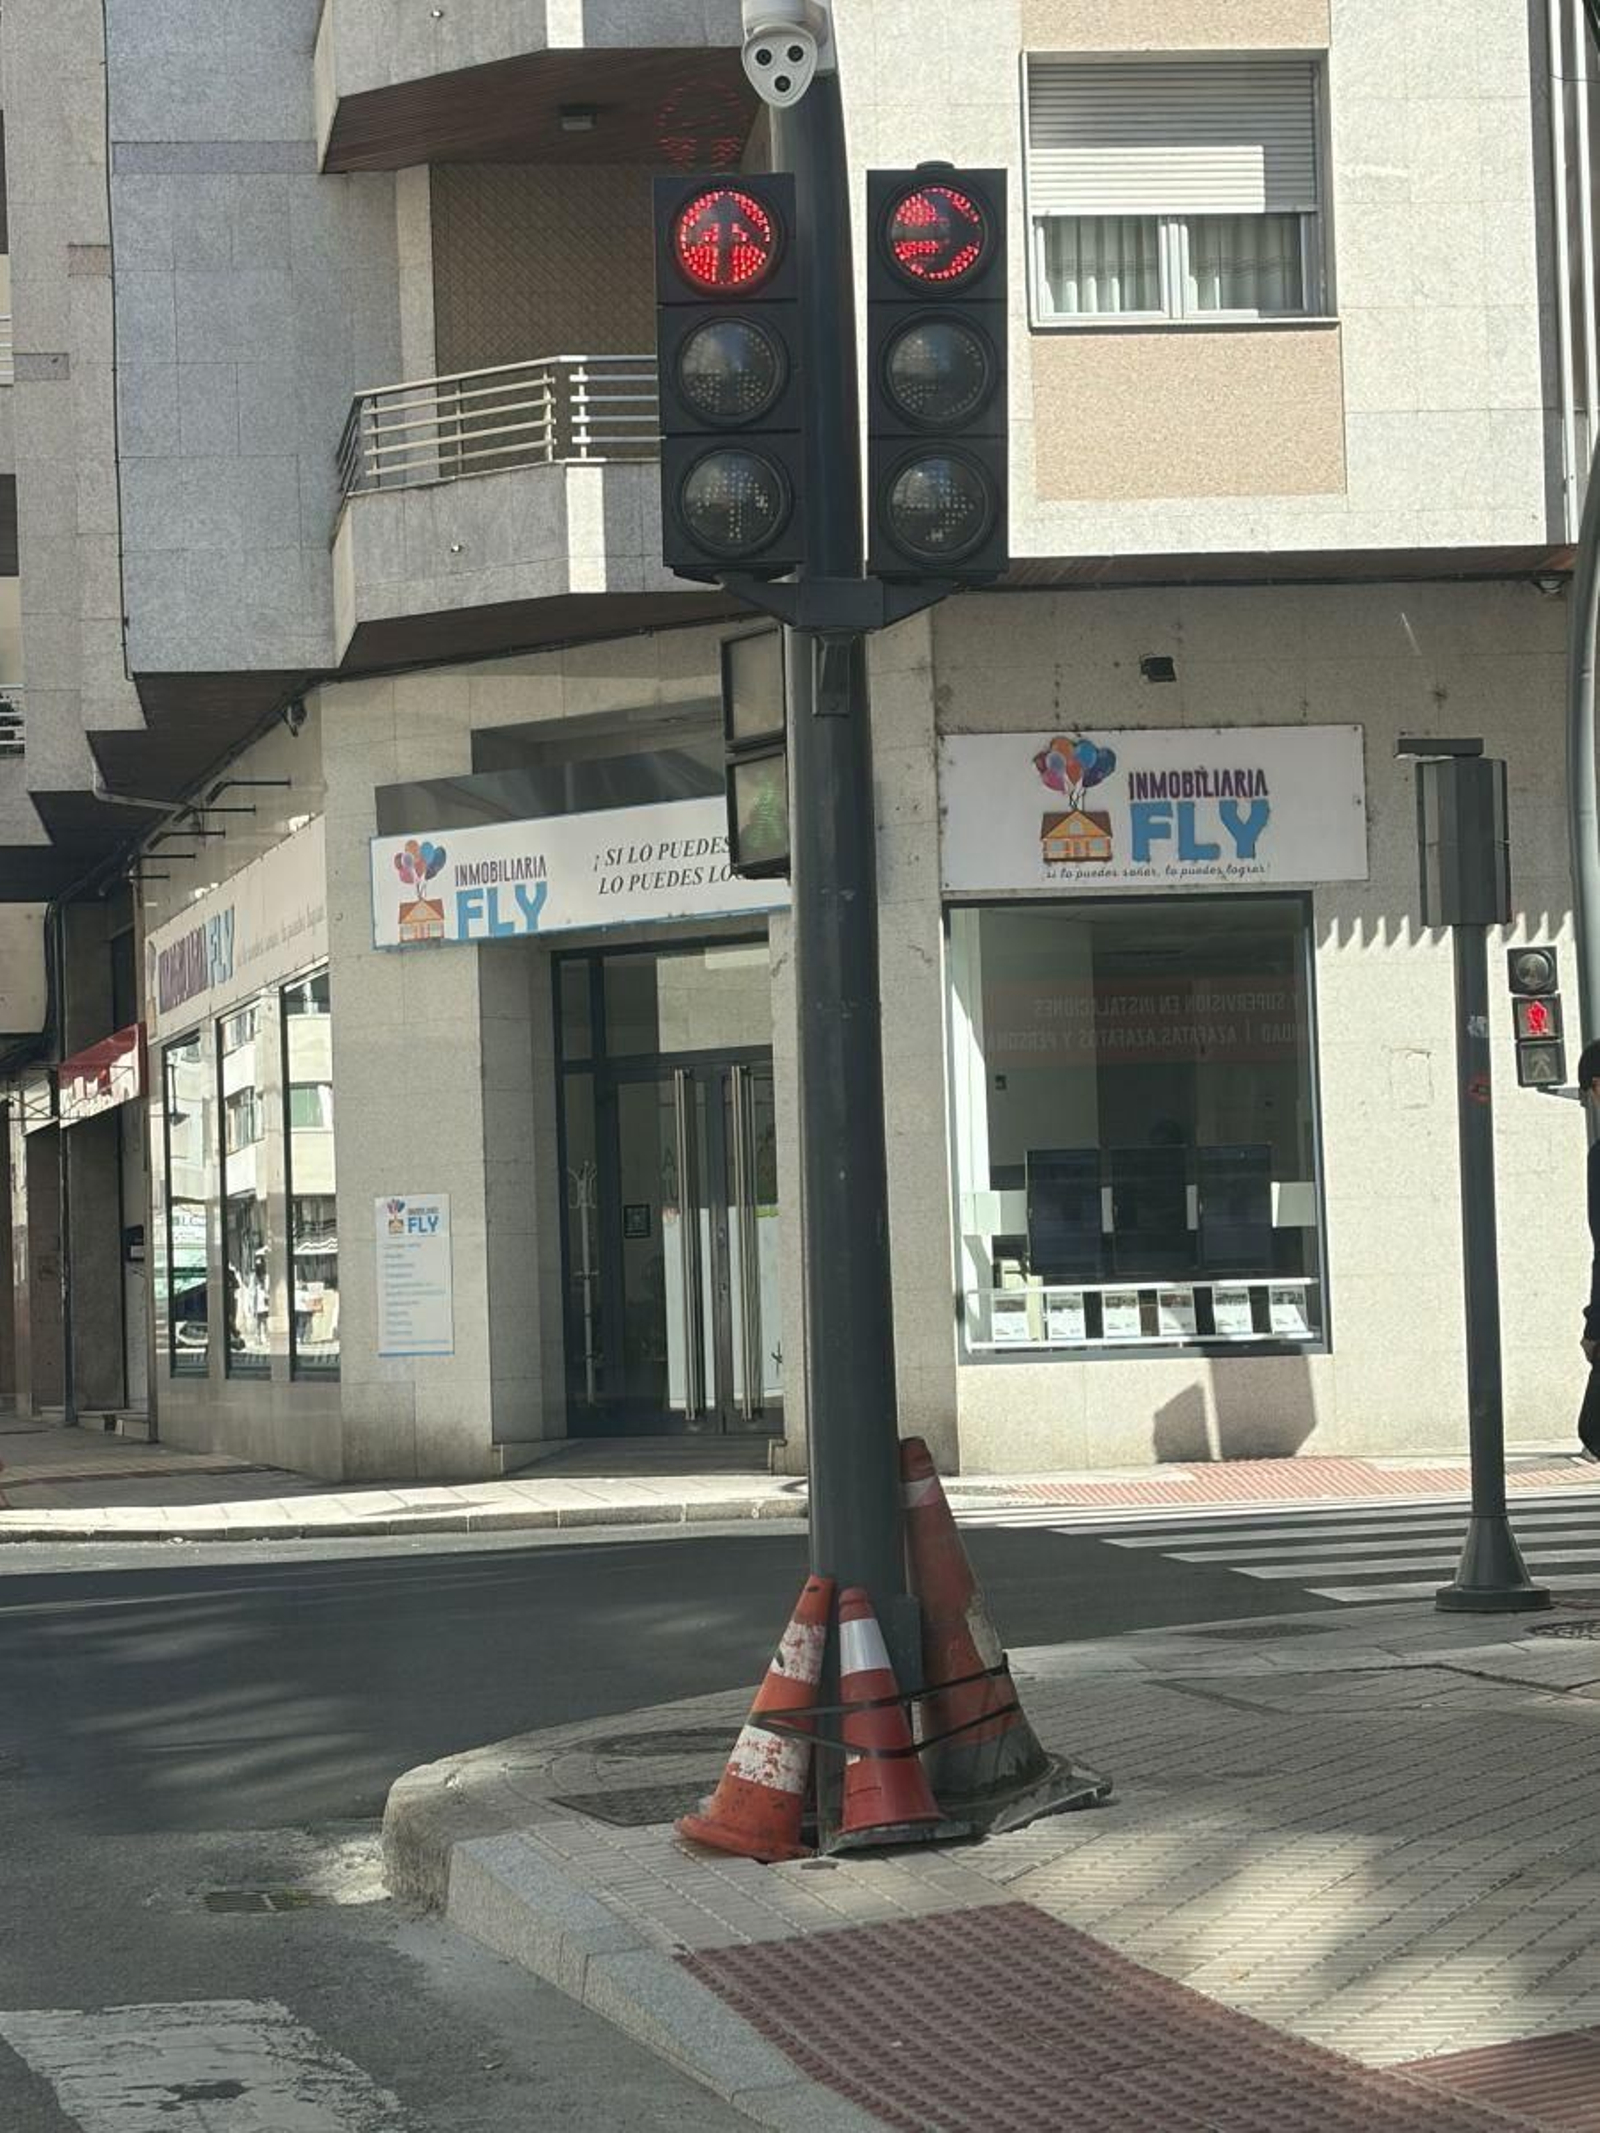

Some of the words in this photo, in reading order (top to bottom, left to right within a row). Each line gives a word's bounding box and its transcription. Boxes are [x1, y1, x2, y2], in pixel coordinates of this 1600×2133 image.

[1129, 769, 1269, 800] INMOBILIARIA
[1130, 798, 1270, 863] FLY
[628, 843, 653, 864] LO
[454, 854, 547, 888] INMOBILIARIA
[598, 875, 625, 895] LO
[629, 866, 704, 892] PUEDES
[456, 880, 548, 940] FLY
[207, 903, 236, 989] FLY
[407, 1214, 439, 1234] FLY
